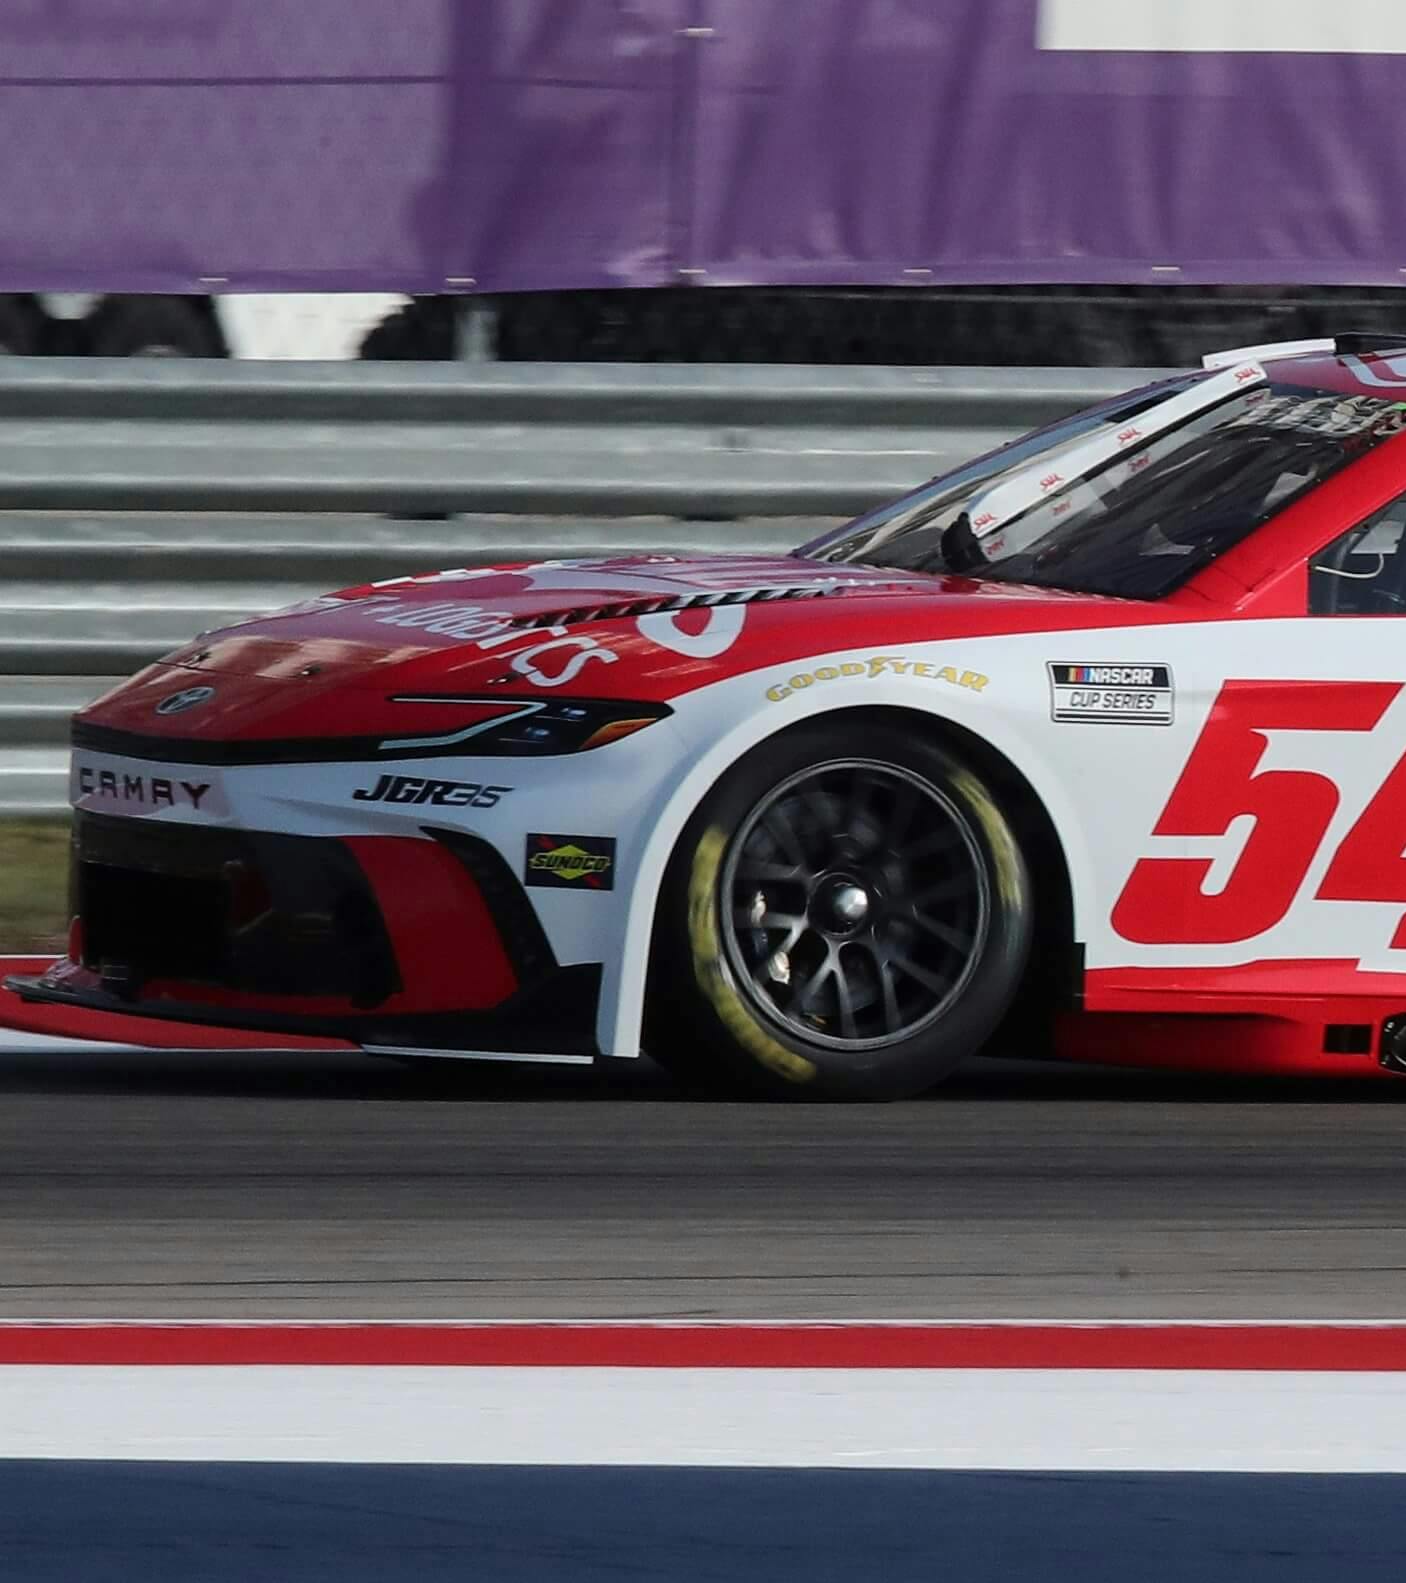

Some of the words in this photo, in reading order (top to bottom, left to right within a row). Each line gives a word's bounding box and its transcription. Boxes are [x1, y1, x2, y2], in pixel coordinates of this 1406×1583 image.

[765, 656, 990, 702] GOODYEAR
[1089, 667, 1154, 685] NASCAR
[1070, 691, 1101, 707] CUP
[1102, 693, 1156, 710] SERIES
[79, 767, 211, 809] CAMRY
[531, 853, 610, 872] SUNOCO
